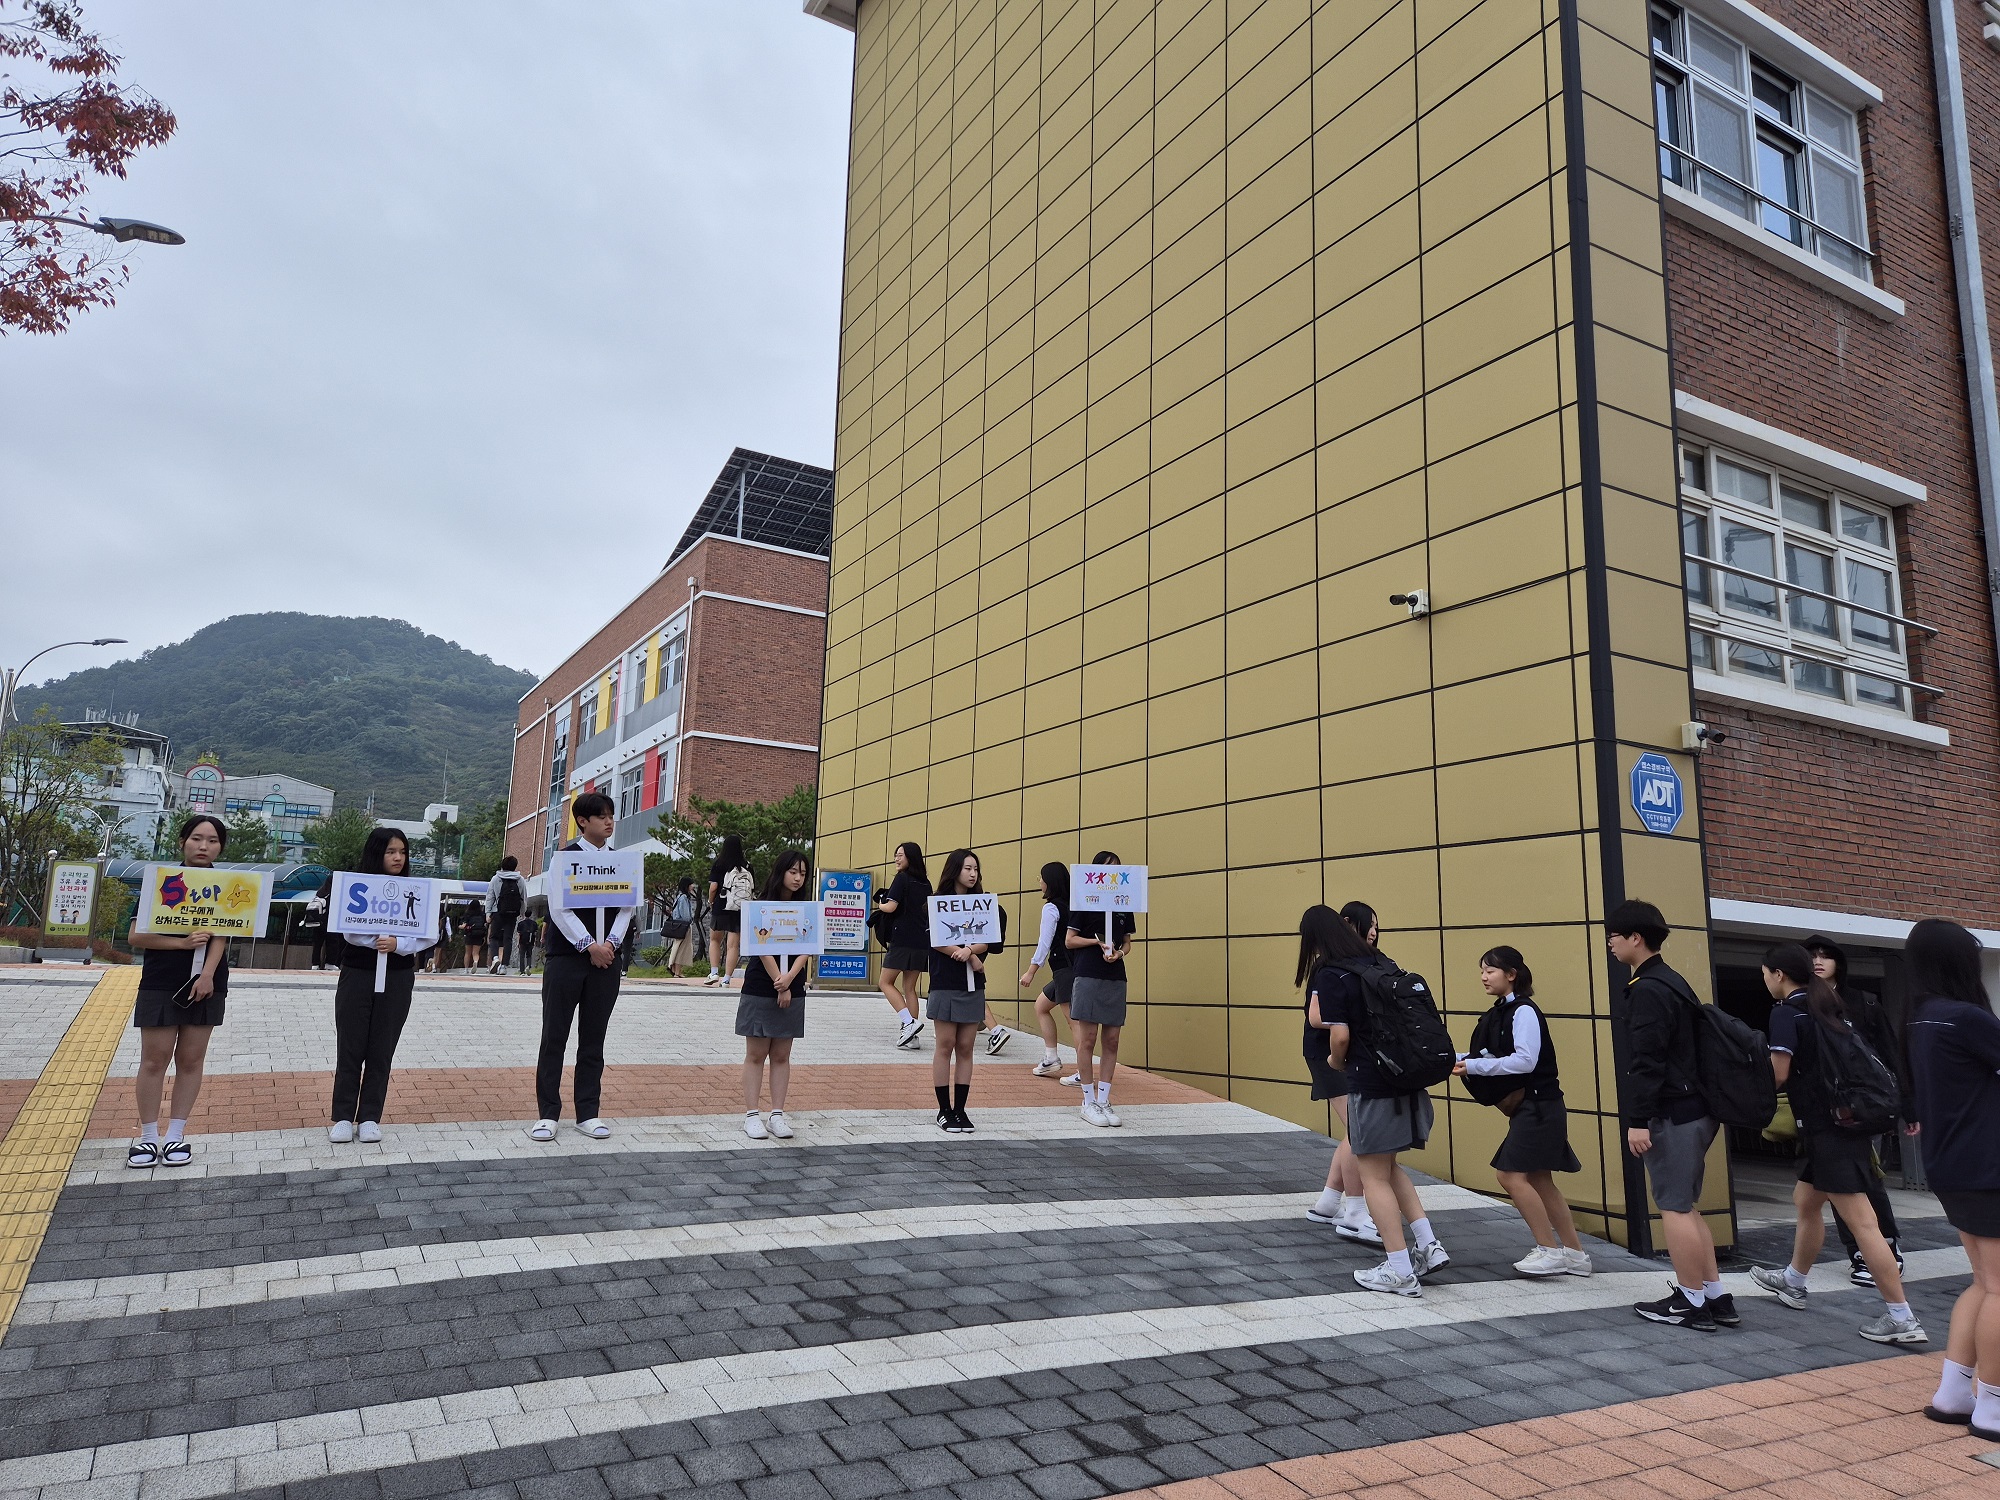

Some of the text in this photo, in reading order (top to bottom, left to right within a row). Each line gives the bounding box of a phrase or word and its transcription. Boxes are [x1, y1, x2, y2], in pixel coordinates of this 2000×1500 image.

[1641, 779, 1674, 808] ADT
[571, 863, 616, 875] T: Think
[347, 882, 402, 917] Stop
[937, 899, 992, 912] RELAY
[180, 906, 215, 915] 친구에게
[155, 915, 190, 926] 상처주는
[192, 916, 209, 927] 말은
